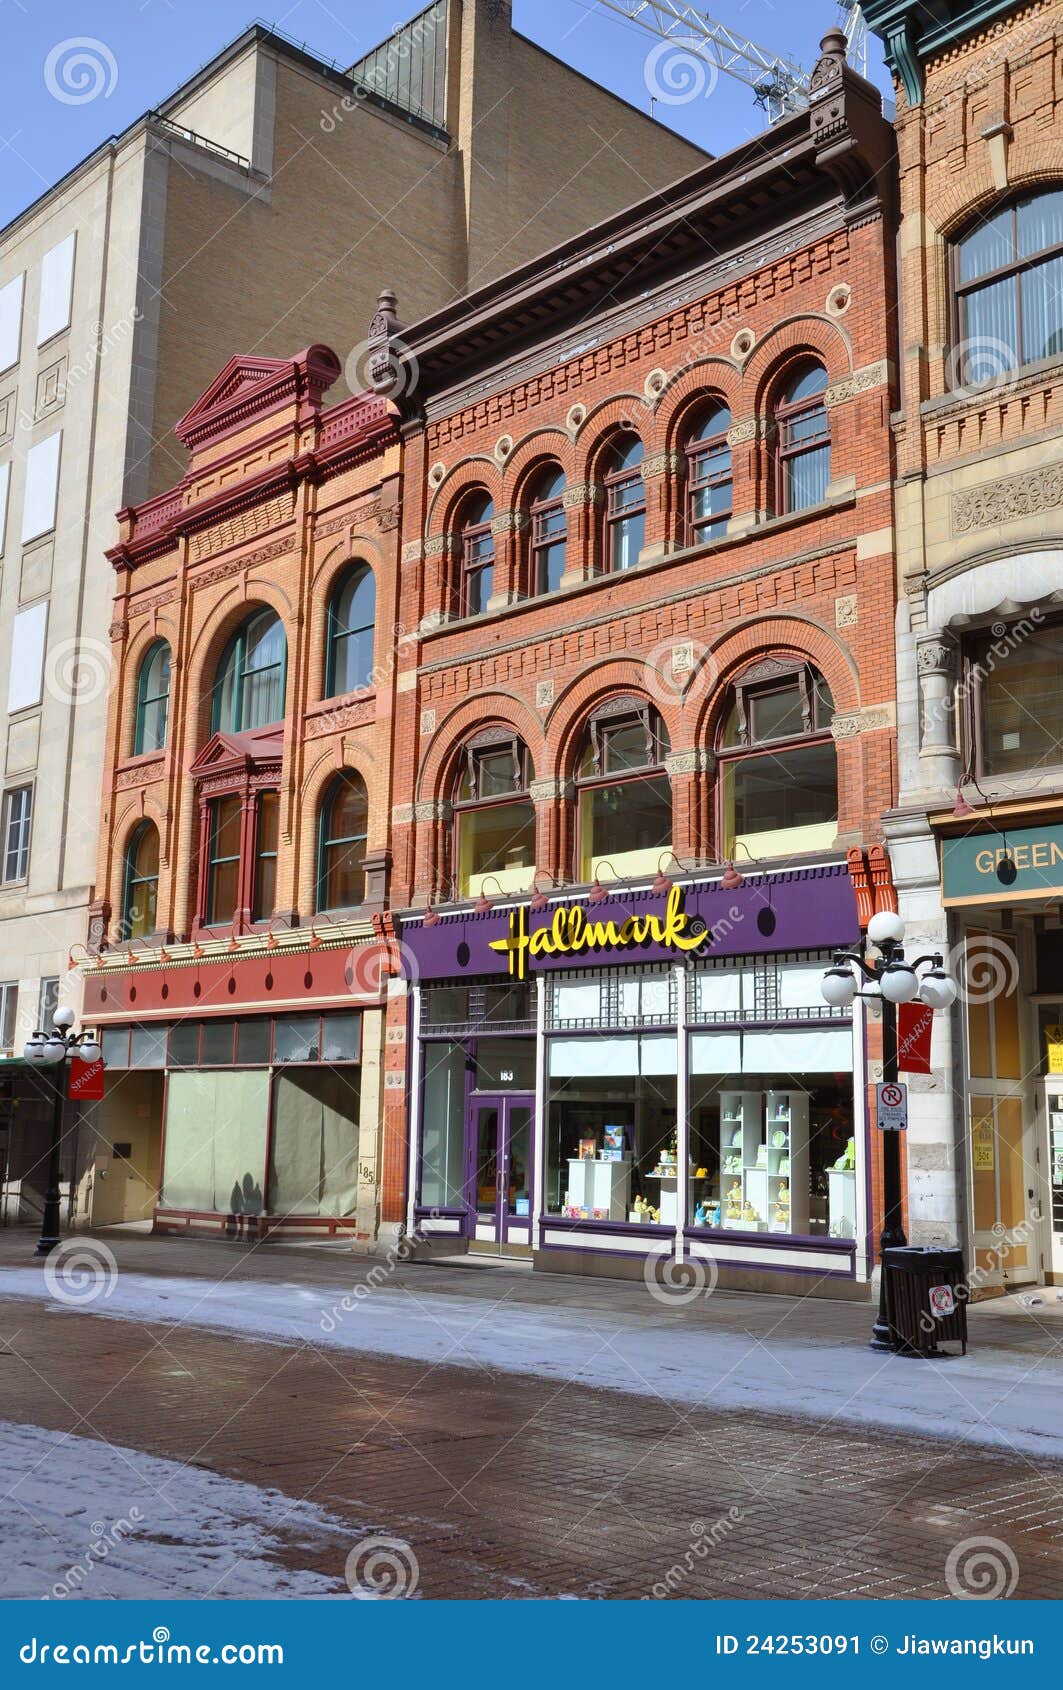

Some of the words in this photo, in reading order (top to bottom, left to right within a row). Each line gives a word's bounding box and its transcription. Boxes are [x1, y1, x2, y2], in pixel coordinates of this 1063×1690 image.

[488, 886, 708, 979] Hallmark
[900, 1008, 933, 1059] SPARKS
[71, 1061, 102, 1091] SPARKS
[500, 1071, 513, 1081] 183
[359, 1162, 374, 1183] 185
